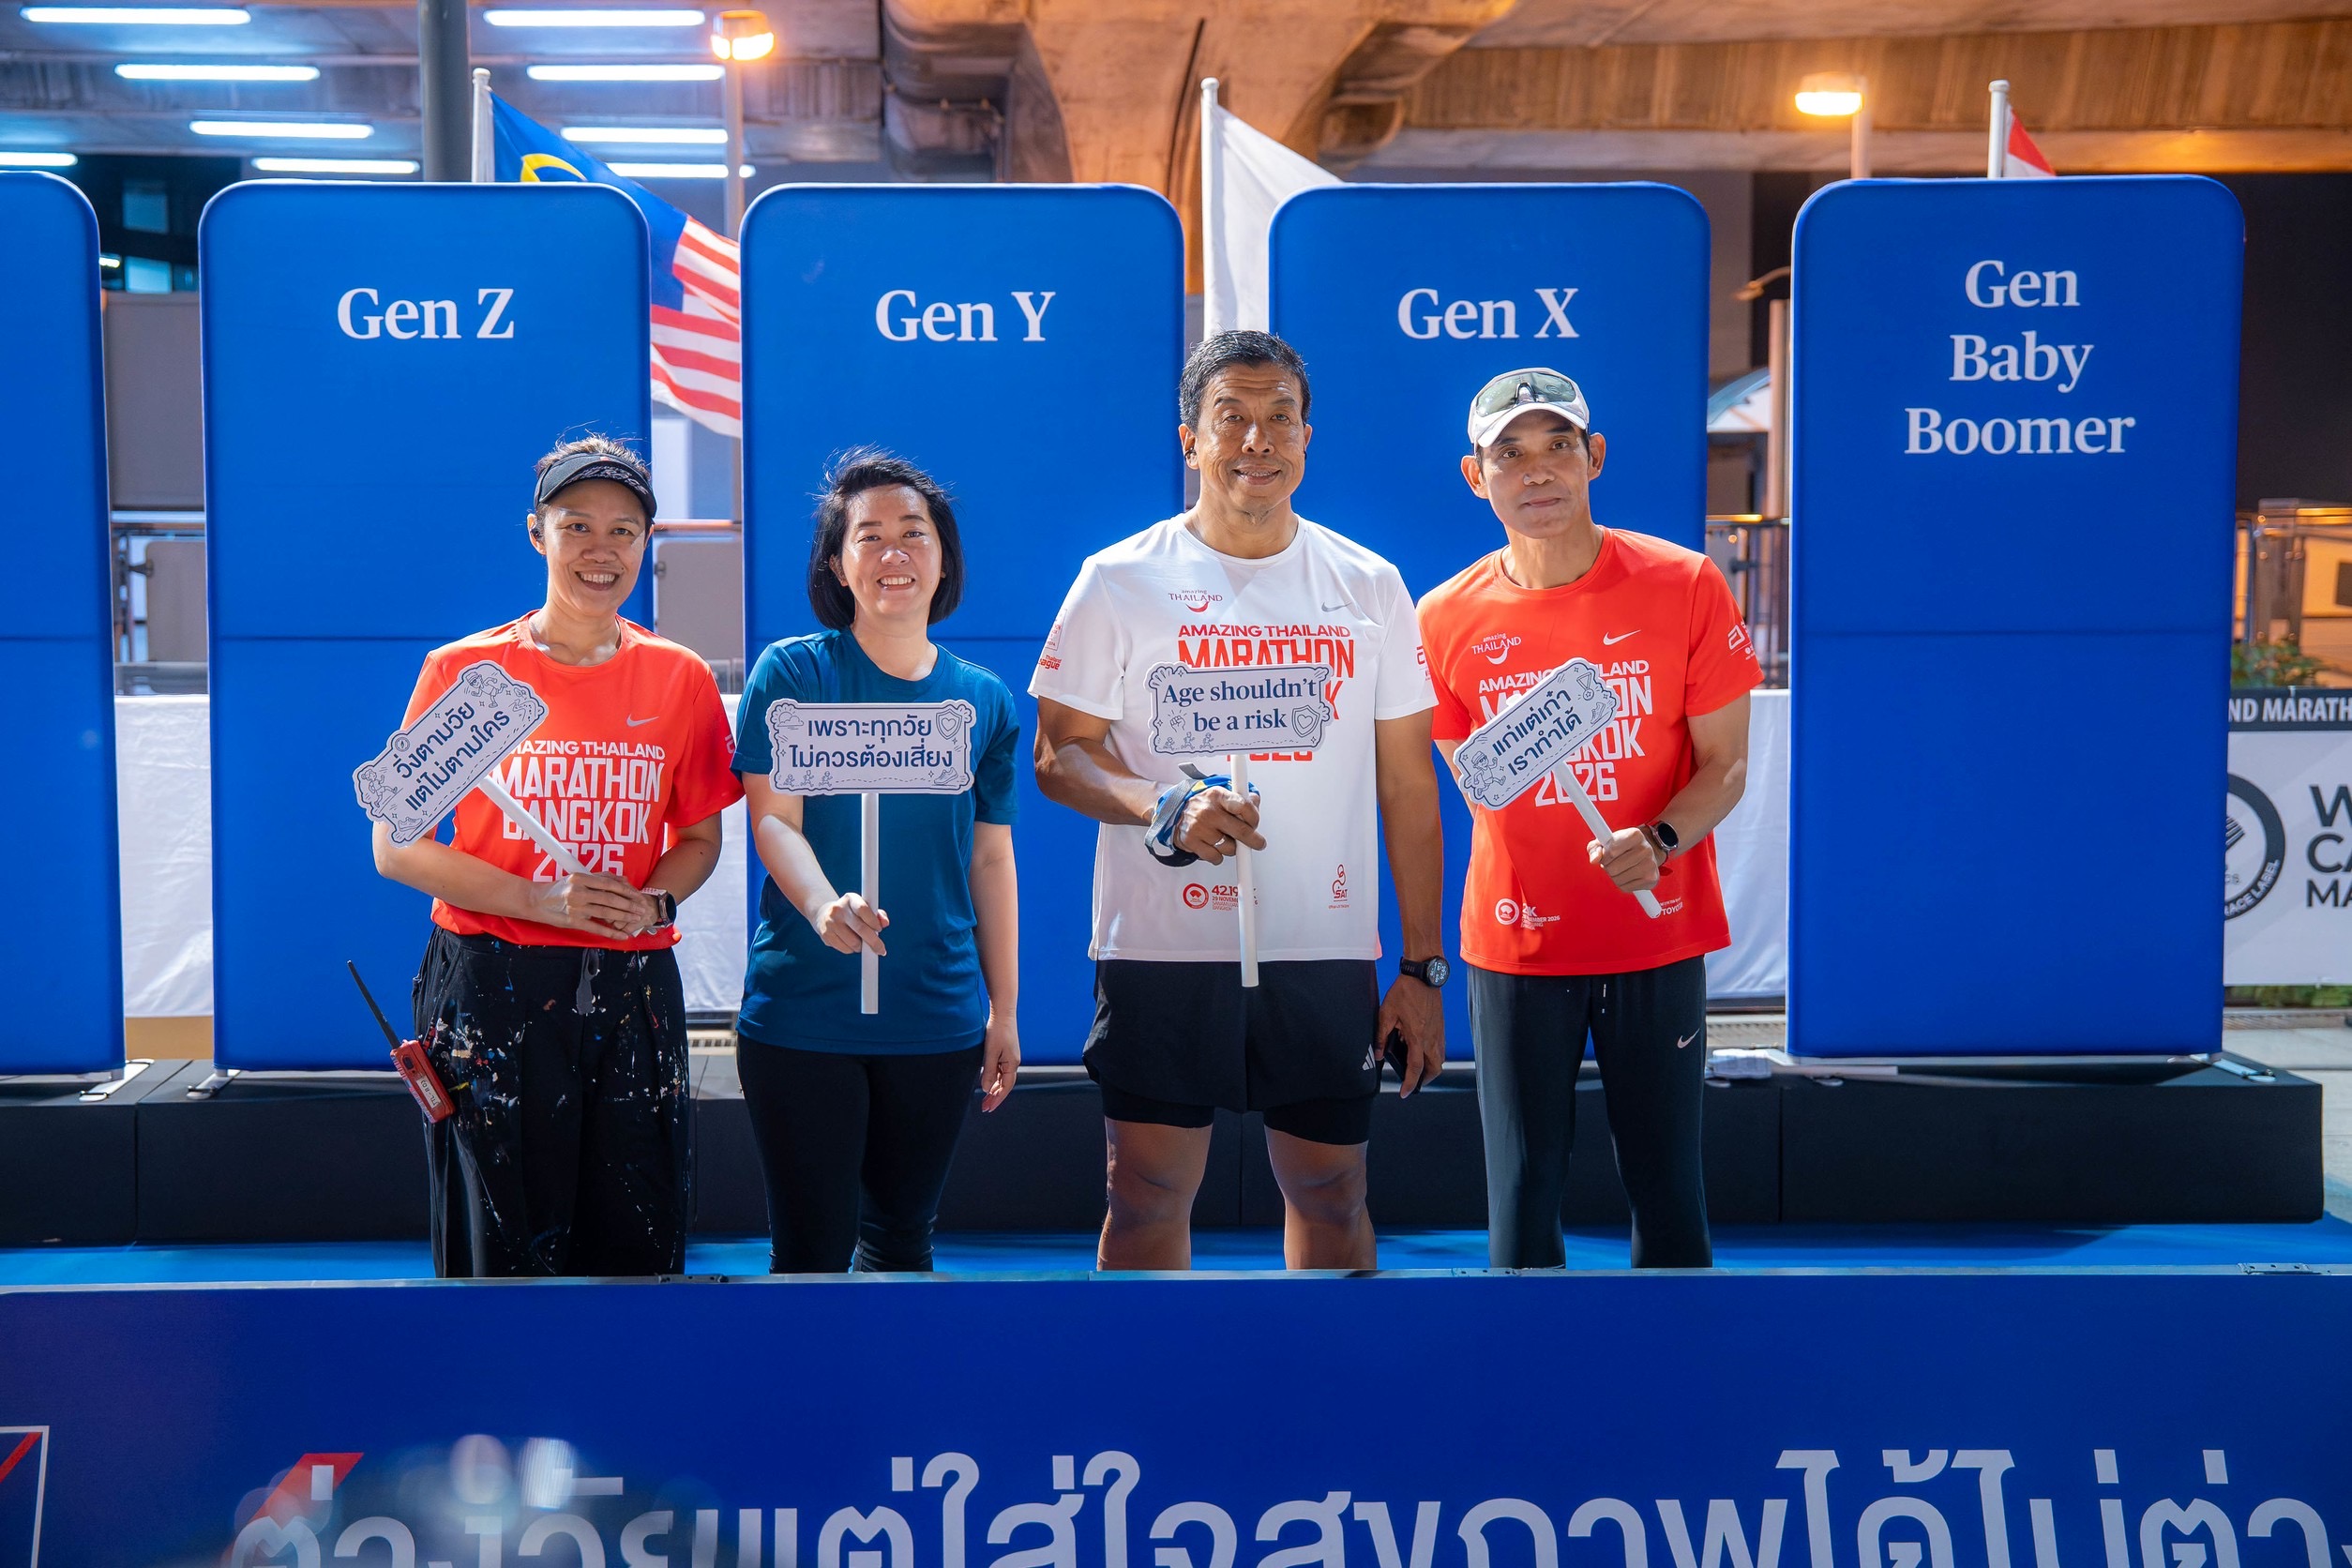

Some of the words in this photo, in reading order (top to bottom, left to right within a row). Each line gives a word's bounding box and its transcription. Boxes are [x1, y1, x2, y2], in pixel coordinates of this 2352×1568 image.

[1966, 260, 2078, 308] Gen
[338, 288, 460, 339] Gen
[476, 288, 514, 339] Z
[875, 290, 998, 342] Gen
[1012, 290, 1056, 341] Y
[1398, 288, 1519, 339] Gen
[1535, 288, 1579, 339] X
[1951, 331, 2093, 393] Baby
[1905, 408, 2135, 455] Boomer
[1168, 593, 1224, 602] THAILAND
[1178, 624, 1262, 638] AMAZING
[1264, 625, 1350, 638] THAILAND
[1471, 636, 1522, 655] THAILAND
[1178, 639, 1354, 679] MARATHON
[1162, 684, 1205, 708] Age
[1210, 677, 1317, 702] shouldn't
[392, 701, 475, 779] วิ่งตามวัย
[807, 714, 932, 744] เพราะทุกวัย
[1193, 711, 1221, 732] be
[1226, 716, 1240, 731] a
[1244, 708, 1288, 730] risk
[1491, 688, 1572, 757] แก่แต่เก๋า
[1507, 705, 1583, 776] เราทำได้
[404, 710, 510, 812] แต่ไม่ตามใคร
[510, 739, 580, 756] AZING
[580, 741, 666, 761] THAILAND
[789, 738, 953, 768] ไม่ควรต้องเสี่ยง
[489, 756, 665, 803] MARATHON
[1212, 884, 1239, 897] 42.19
[2251, 859, 2281, 900] LABEL
